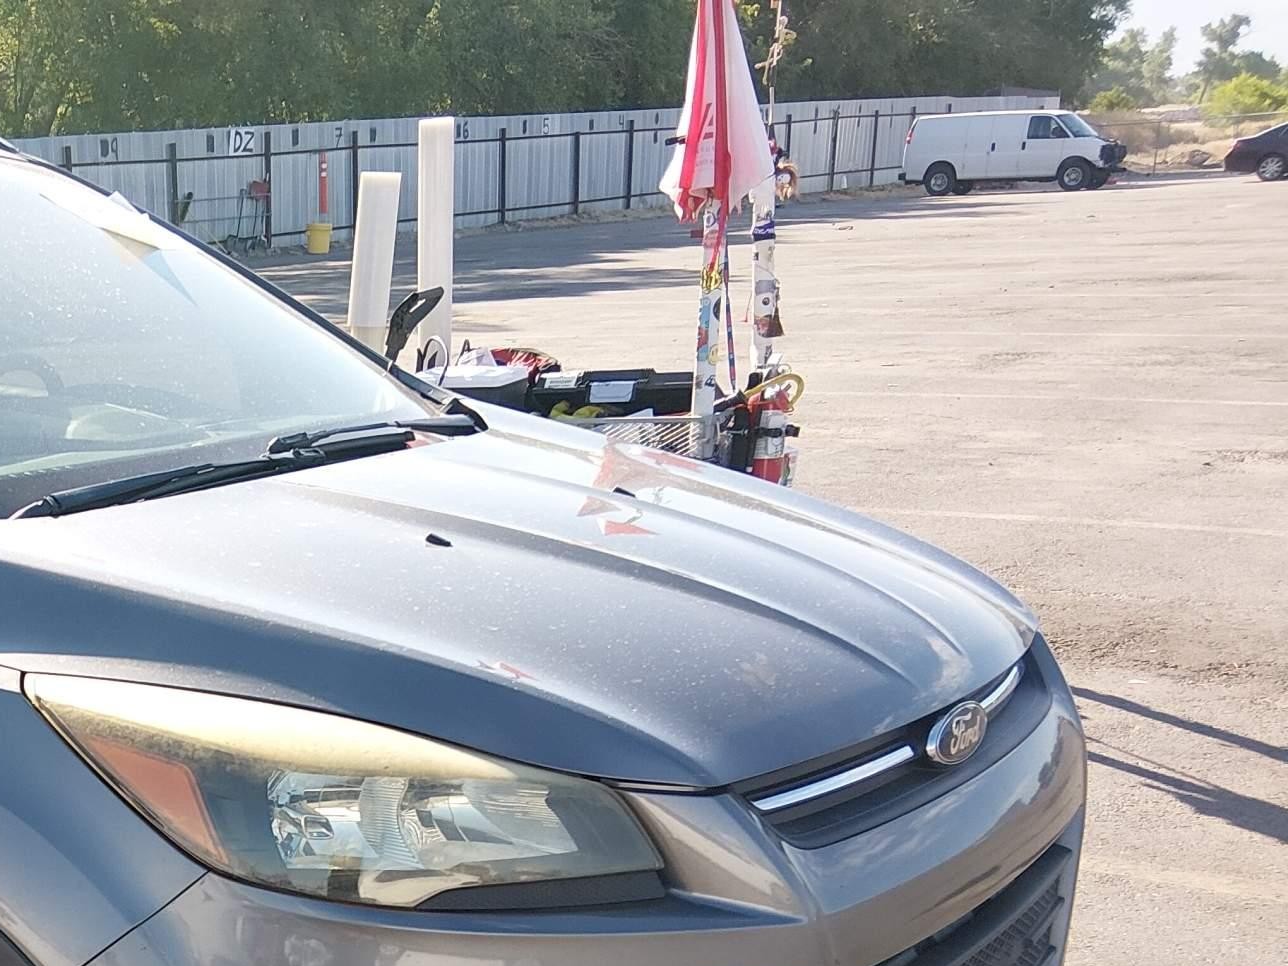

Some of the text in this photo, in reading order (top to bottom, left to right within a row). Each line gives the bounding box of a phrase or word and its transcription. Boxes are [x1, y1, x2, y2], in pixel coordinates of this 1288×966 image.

[462, 120, 470, 140] 6
[542, 117, 550, 135] 5
[334, 127, 343, 148] 7
[950, 710, 981, 755] Ford
